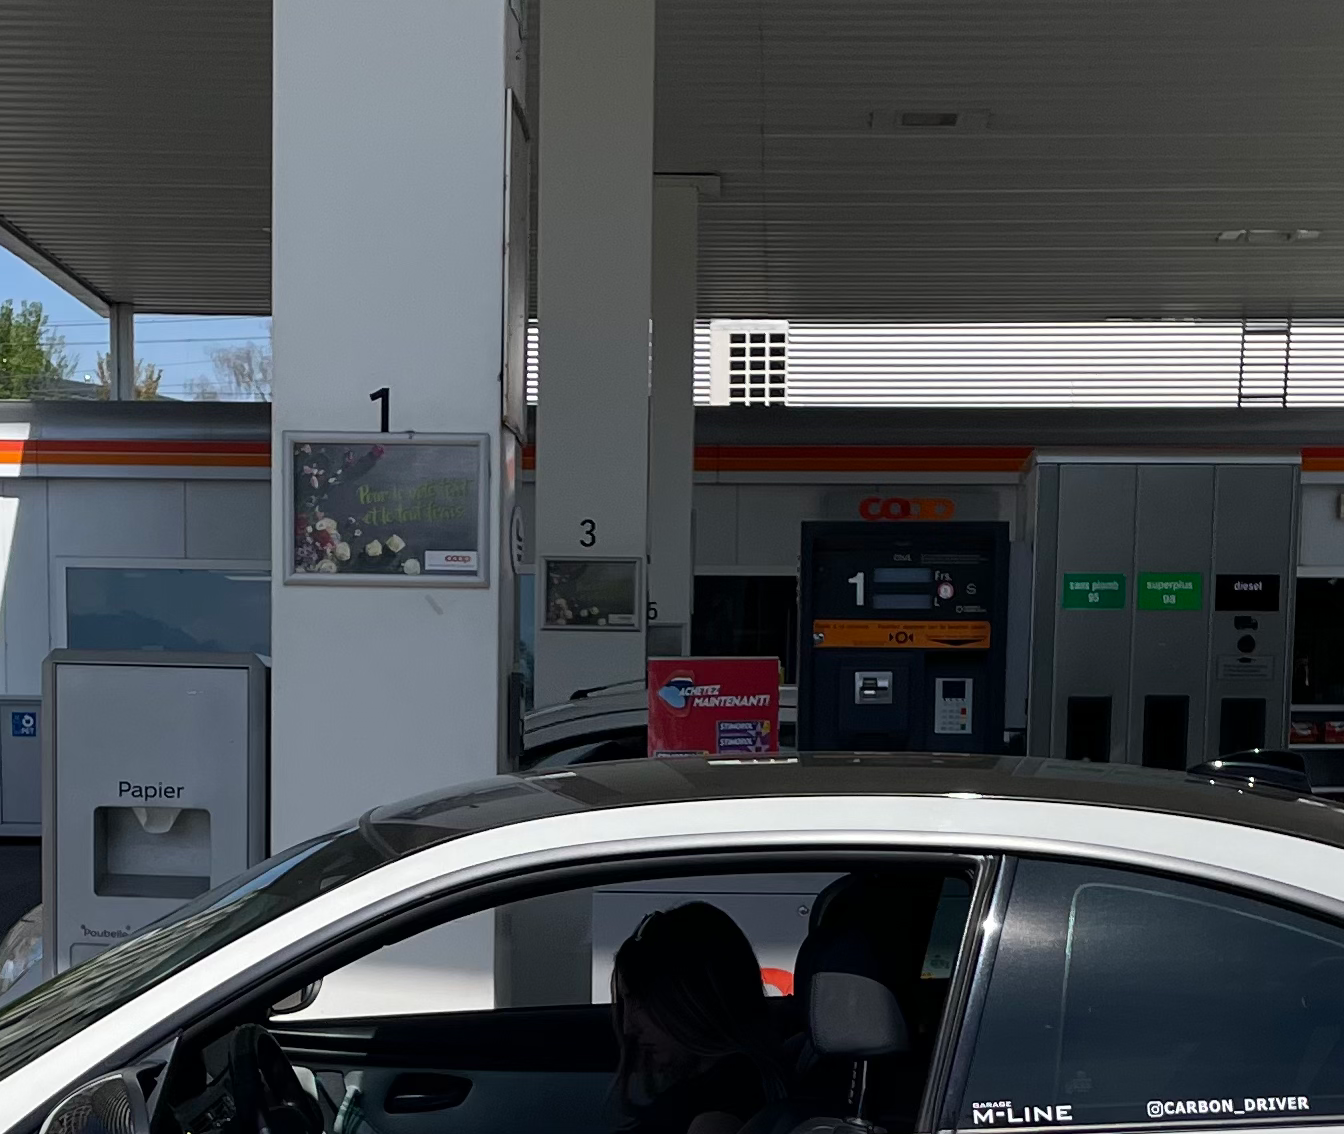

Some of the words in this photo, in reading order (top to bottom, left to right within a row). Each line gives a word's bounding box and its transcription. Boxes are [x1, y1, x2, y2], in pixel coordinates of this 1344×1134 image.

[369, 387, 390, 433] 1
[579, 518, 597, 548] 3
[847, 572, 865, 606] 1
[1146, 580, 1193, 592] superplus
[1234, 580, 1263, 591] diesel
[678, 684, 721, 697] ACHETEZ
[693, 694, 770, 708] MAINTENANT!
[118, 781, 185, 801] Papier
[972, 1101, 1012, 1109] GARAGE
[973, 1105, 1073, 1125] M-LINE
